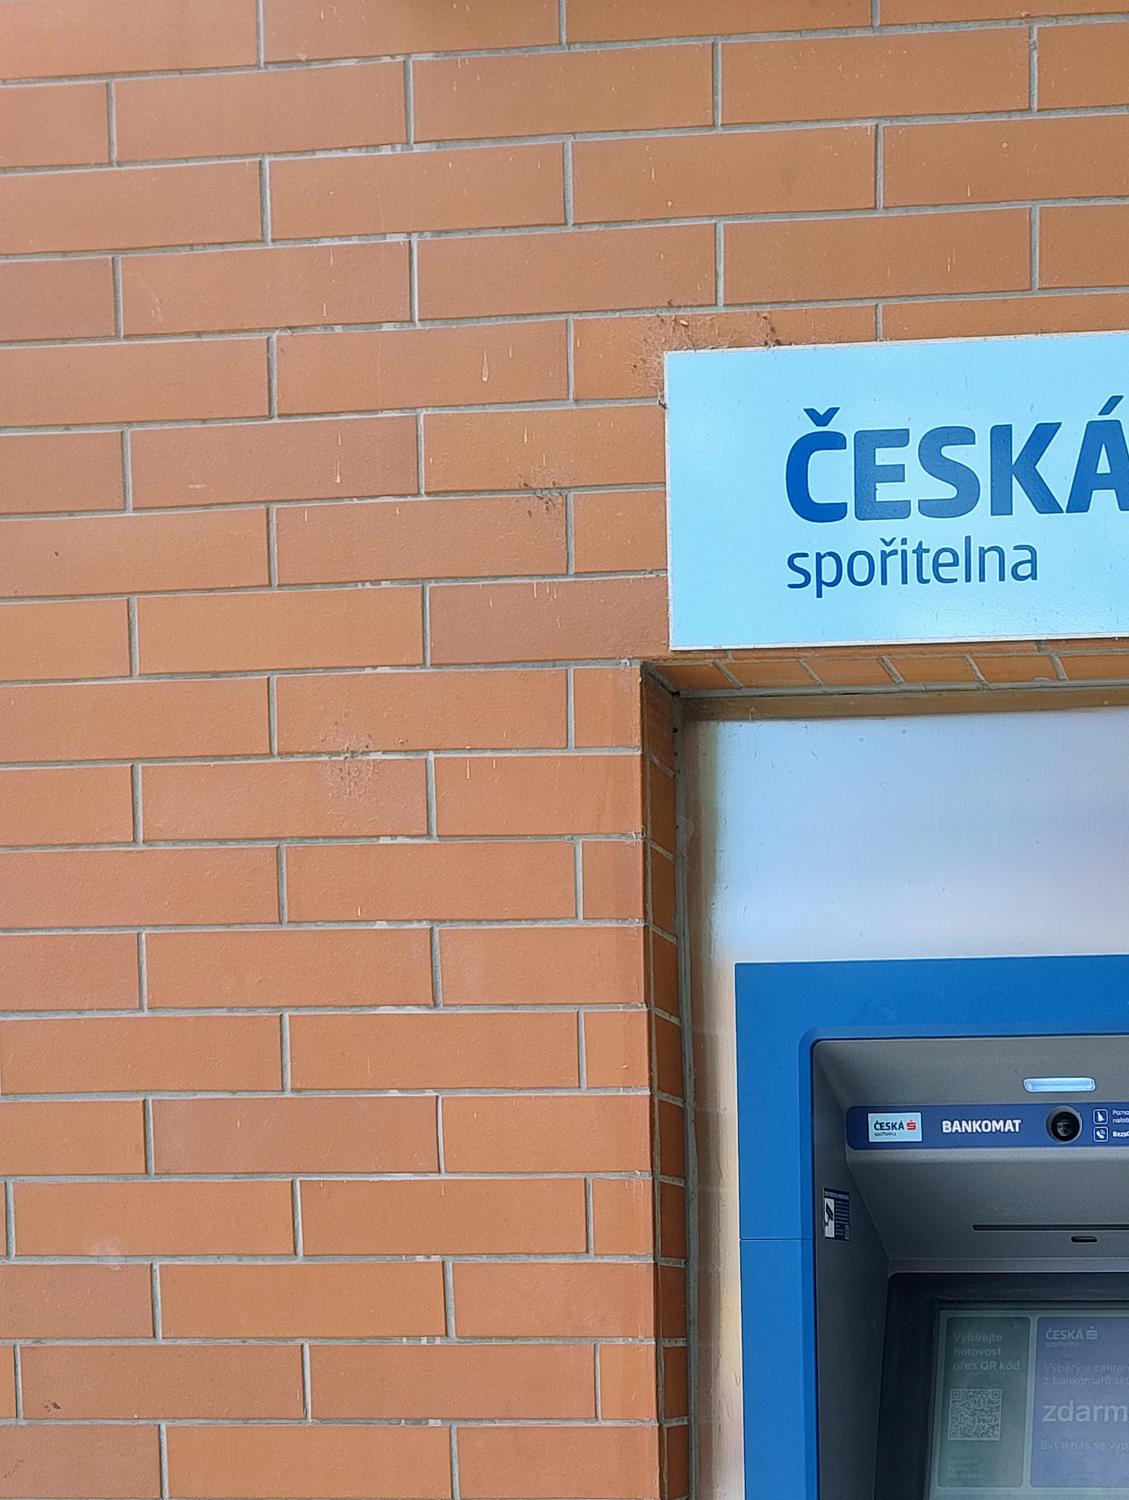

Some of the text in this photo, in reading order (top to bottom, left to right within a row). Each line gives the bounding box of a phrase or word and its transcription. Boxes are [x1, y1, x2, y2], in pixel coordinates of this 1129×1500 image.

[786, 536, 1038, 598] spořitelna
[873, 1119, 905, 1131] ČESKÁ
[941, 1119, 1022, 1133] BANKOMAT
[1045, 1327, 1085, 1341] ČESKÁ
[980, 1360, 998, 1371] QR
[999, 1359, 1020, 1371] kód
